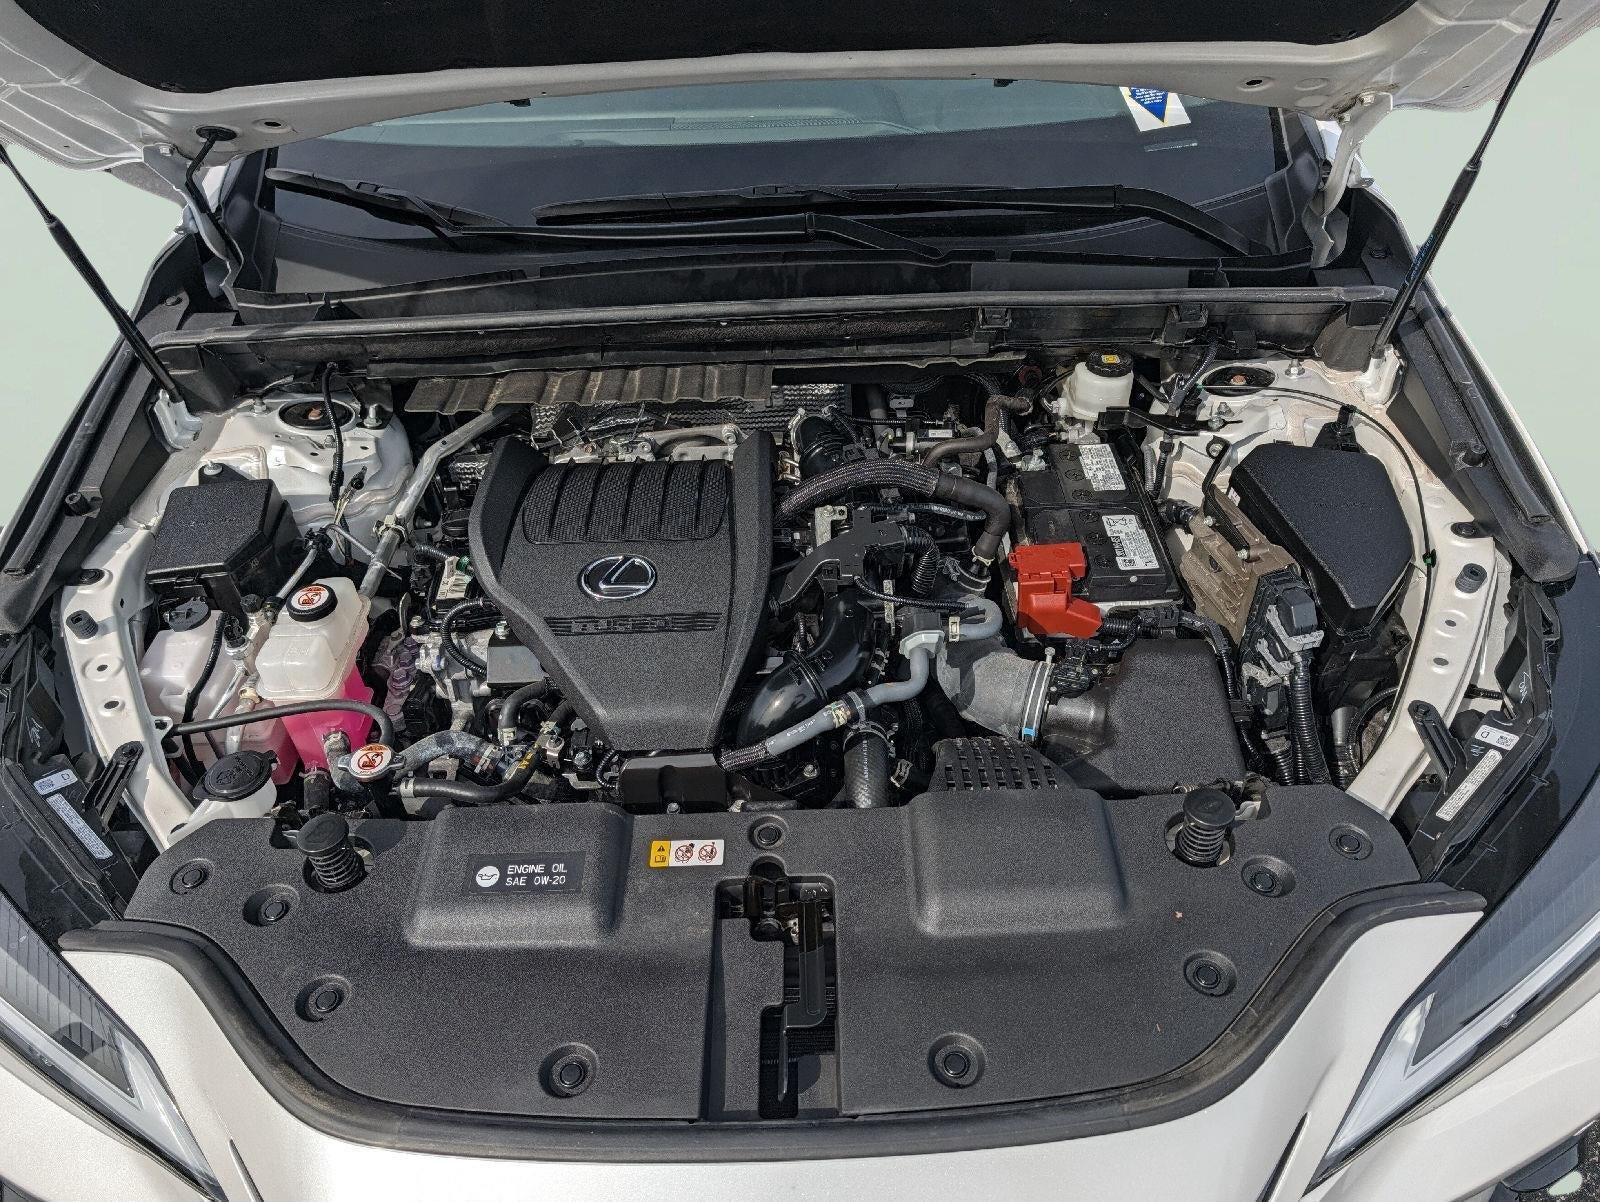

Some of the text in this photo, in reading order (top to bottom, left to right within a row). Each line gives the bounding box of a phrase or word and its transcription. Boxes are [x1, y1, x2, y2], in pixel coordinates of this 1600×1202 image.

[507, 863, 567, 875] ENGINE OIL
[505, 876, 566, 886] SAE 0W-20
